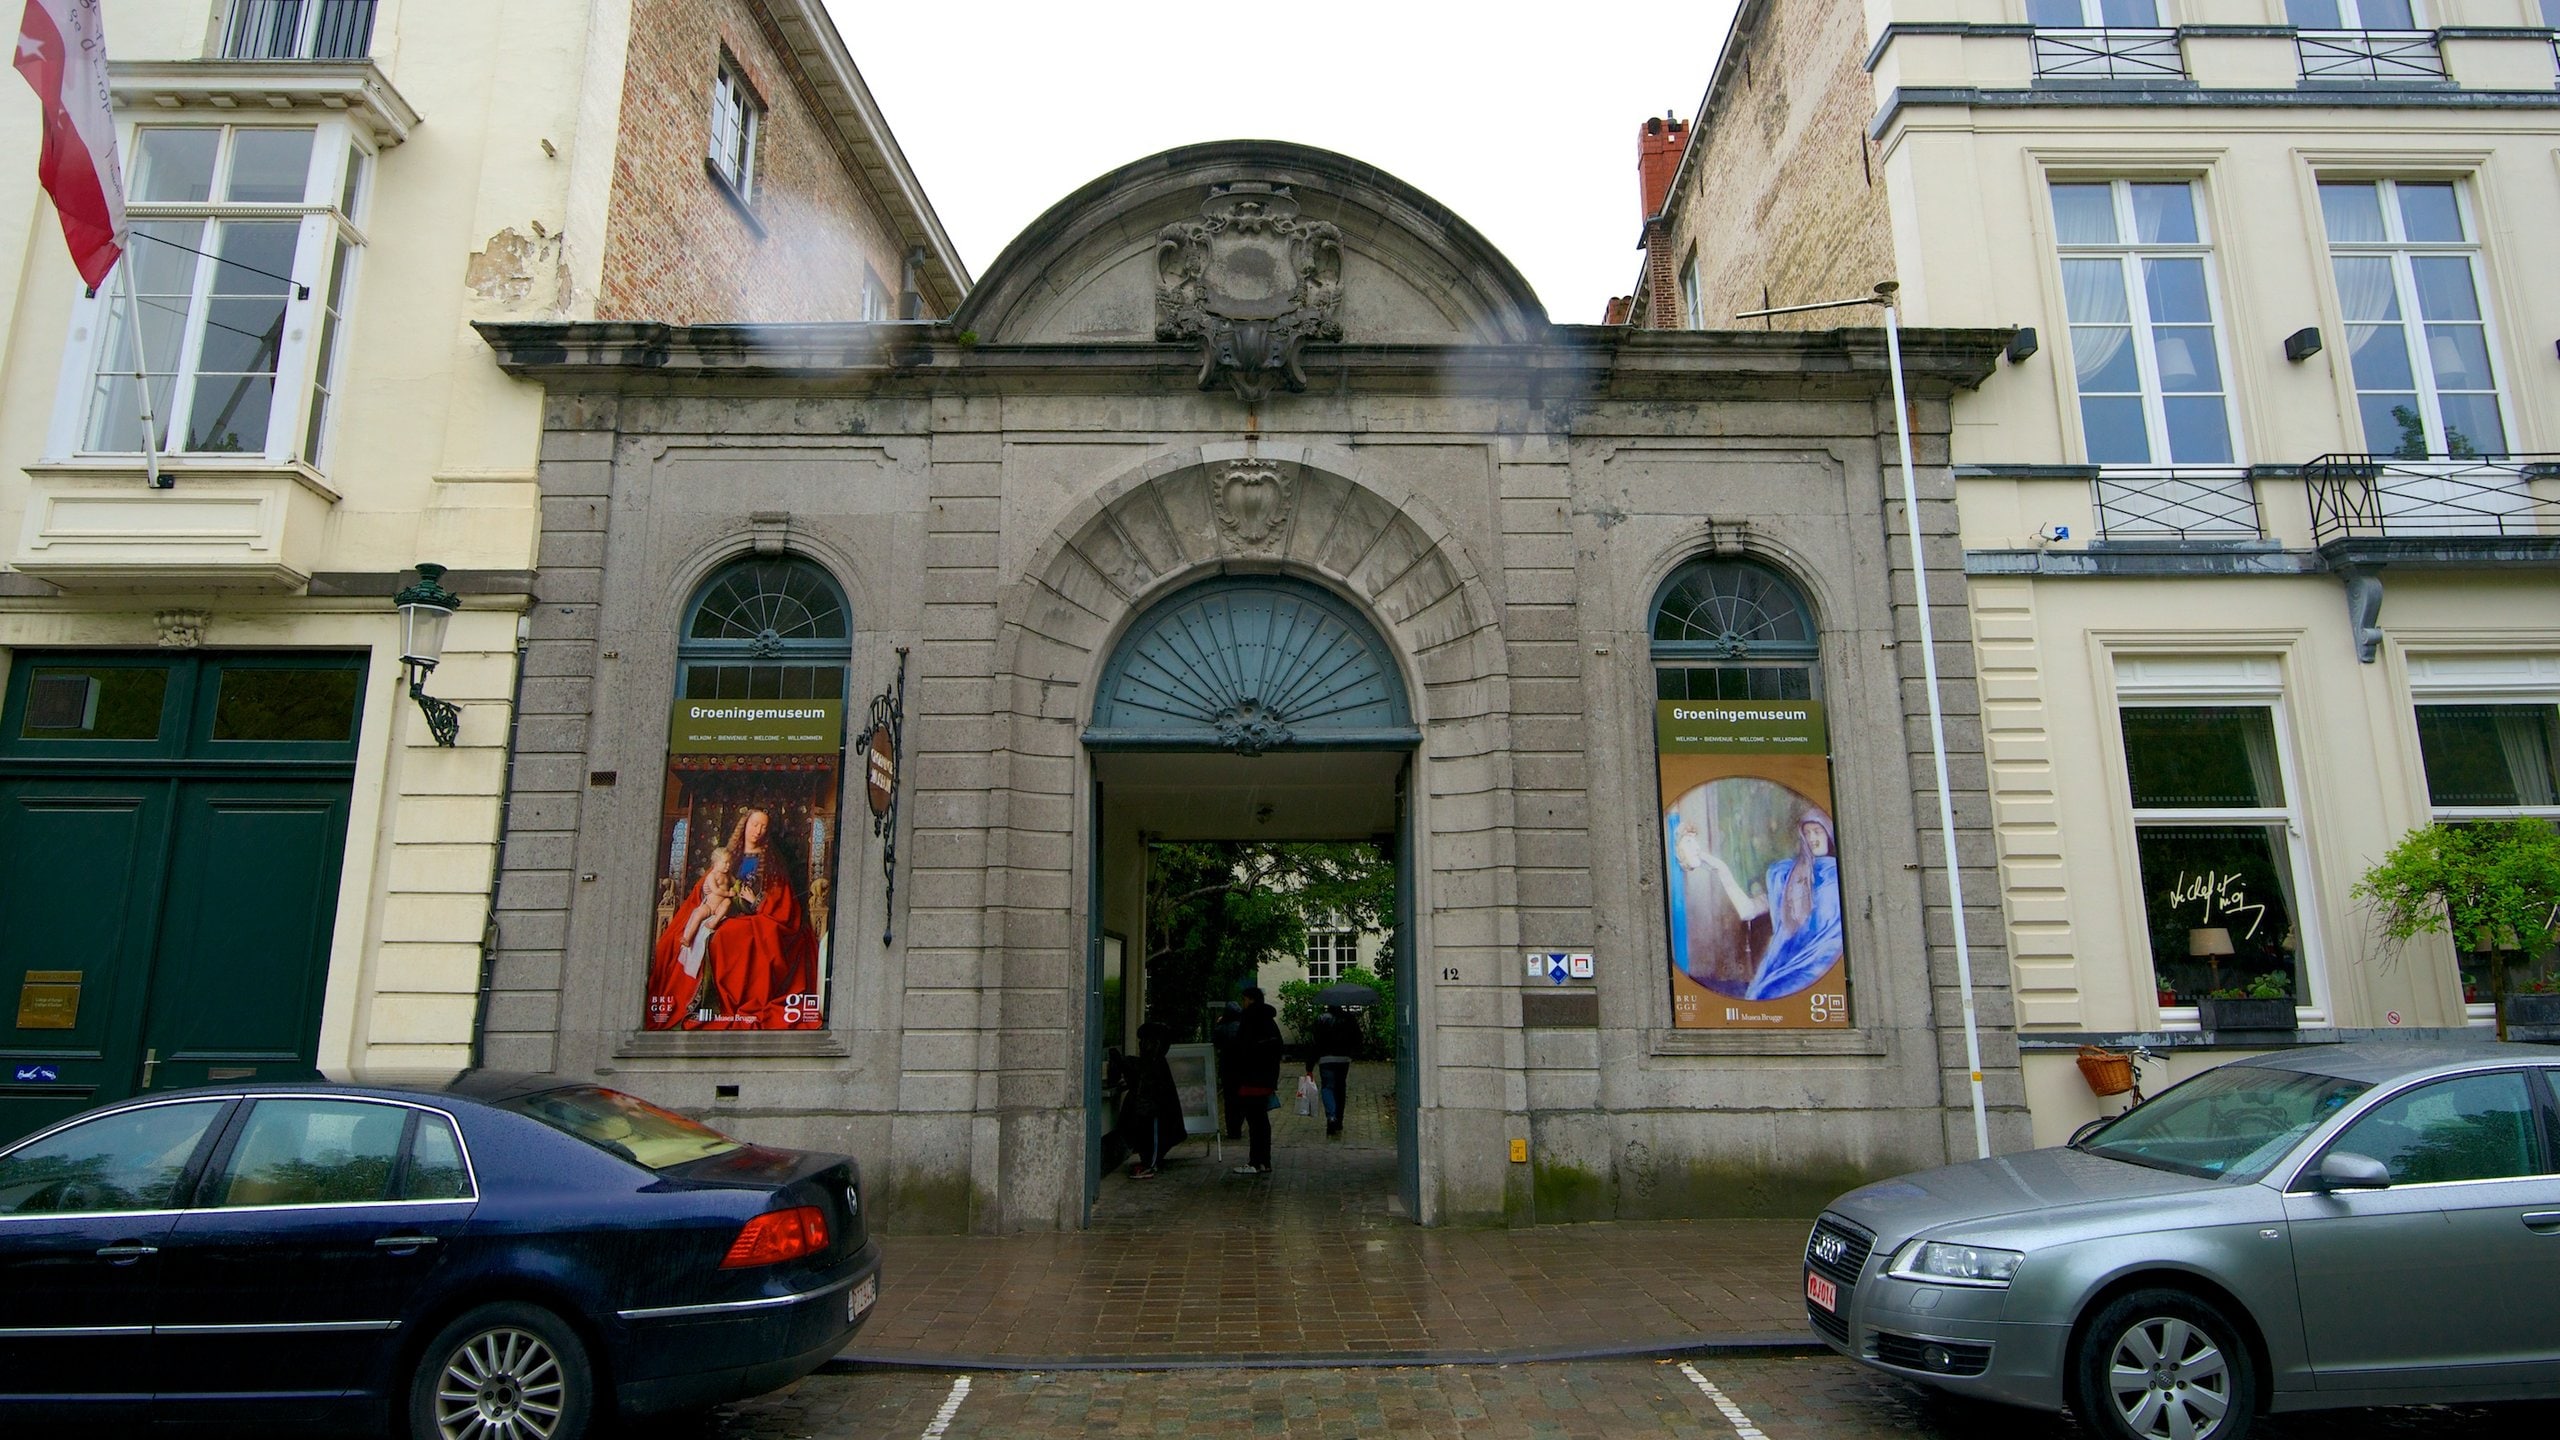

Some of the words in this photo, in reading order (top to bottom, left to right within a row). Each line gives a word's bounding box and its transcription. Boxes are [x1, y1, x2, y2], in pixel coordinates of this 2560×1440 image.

[690, 706, 825, 721] Groeningemuseum
[1673, 708, 1807, 723] Groeningemuseum
[1442, 967, 1460, 981] 12
[1676, 1003, 1698, 1011] GGE
[735, 1014, 758, 1024] Brugge
[1761, 1013, 1784, 1023] Brugge
